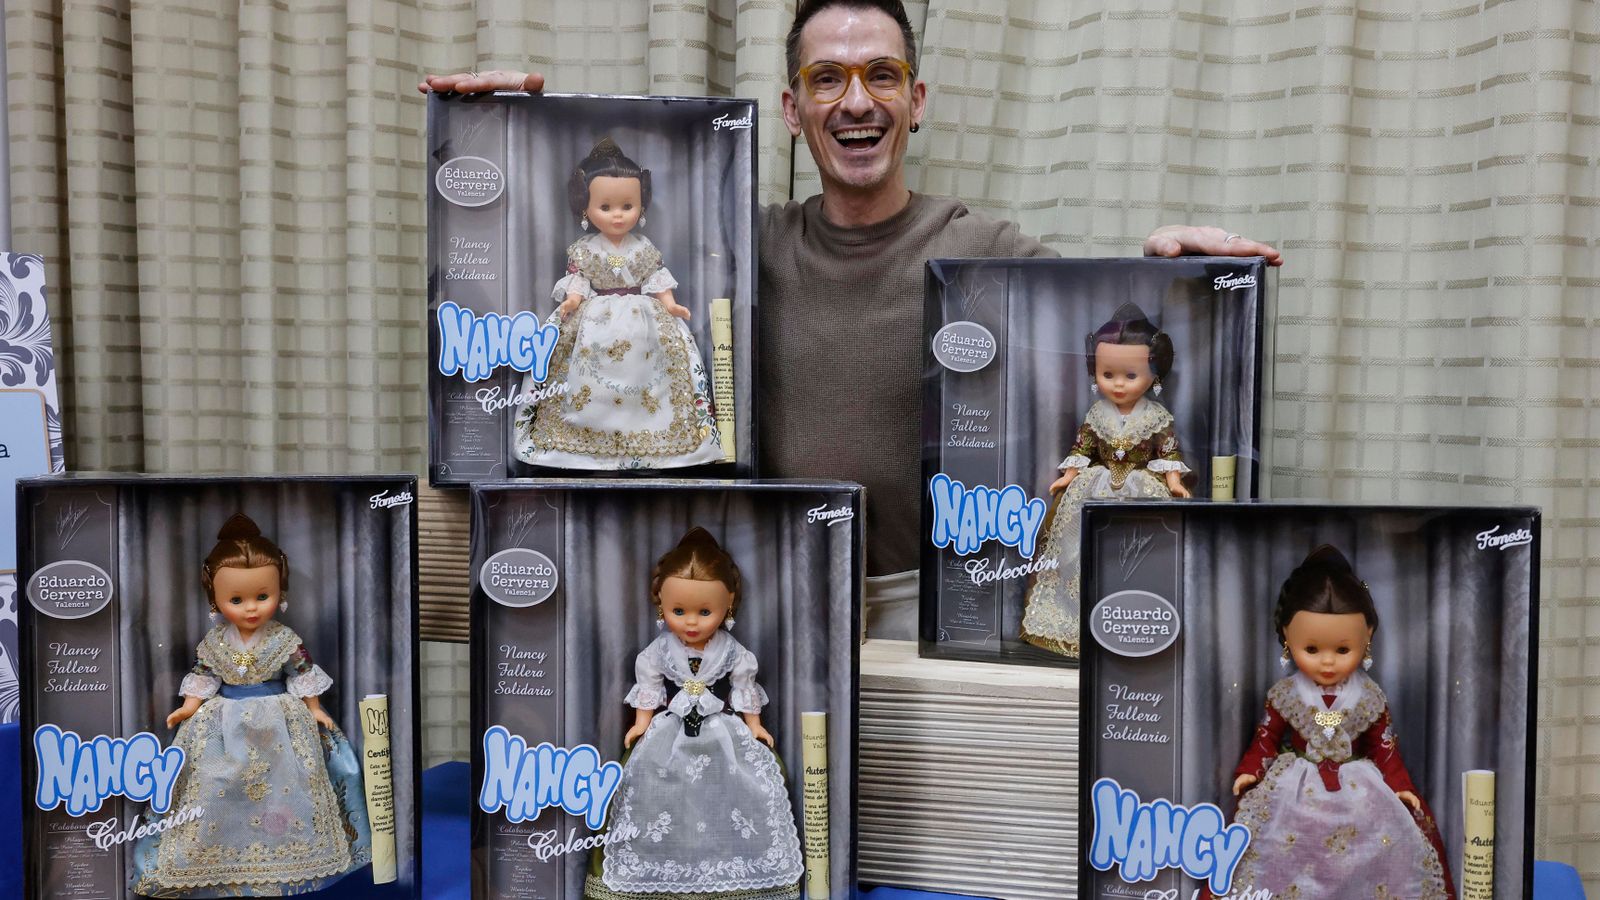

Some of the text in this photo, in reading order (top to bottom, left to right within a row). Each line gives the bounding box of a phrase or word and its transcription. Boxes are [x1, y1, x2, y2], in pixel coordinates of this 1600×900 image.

[445, 167, 499, 180] Eduardo
[445, 178, 497, 190] Cervera
[450, 236, 492, 253] Nancy
[448, 251, 490, 265] Fallera
[445, 267, 498, 281] Solidaria
[437, 301, 560, 383] NANCY
[942, 332, 992, 349] Eduardo
[941, 342, 988, 359] Cervera
[475, 380, 571, 415] Colección
[952, 403, 992, 421] Nancy
[951, 419, 991, 433] Fallera
[947, 434, 997, 449] Solidaria
[440, 466, 447, 475] 2
[930, 473, 1047, 559] NANCY
[491, 562, 552, 577] Eduardo
[964, 555, 1060, 587] Colección
[38, 576, 106, 588] Eduardo
[491, 575, 550, 589] Cervera
[39, 588, 104, 601] Cervera
[504, 588, 536, 596] Valencia
[1101, 606, 1172, 621] Eduardo
[1102, 620, 1170, 635] Cervera
[1118, 635, 1154, 644] Valencia
[49, 642, 102, 660] Nancy
[500, 644, 548, 664] Nancy
[46, 660, 100, 675] Fallera
[497, 662, 546, 678] Fallera
[44, 678, 109, 693] Solidaria
[494, 681, 554, 697] Solidaria
[1108, 684, 1163, 707] Nancy
[1105, 703, 1161, 722] Fallera
[1102, 724, 1170, 744] Solidaria
[34, 724, 186, 817] NANCY
[479, 725, 623, 830] NANCY
[86, 805, 205, 852] Colección
[527, 822, 641, 864] Colección
[1089, 777, 1251, 897] NANCY
